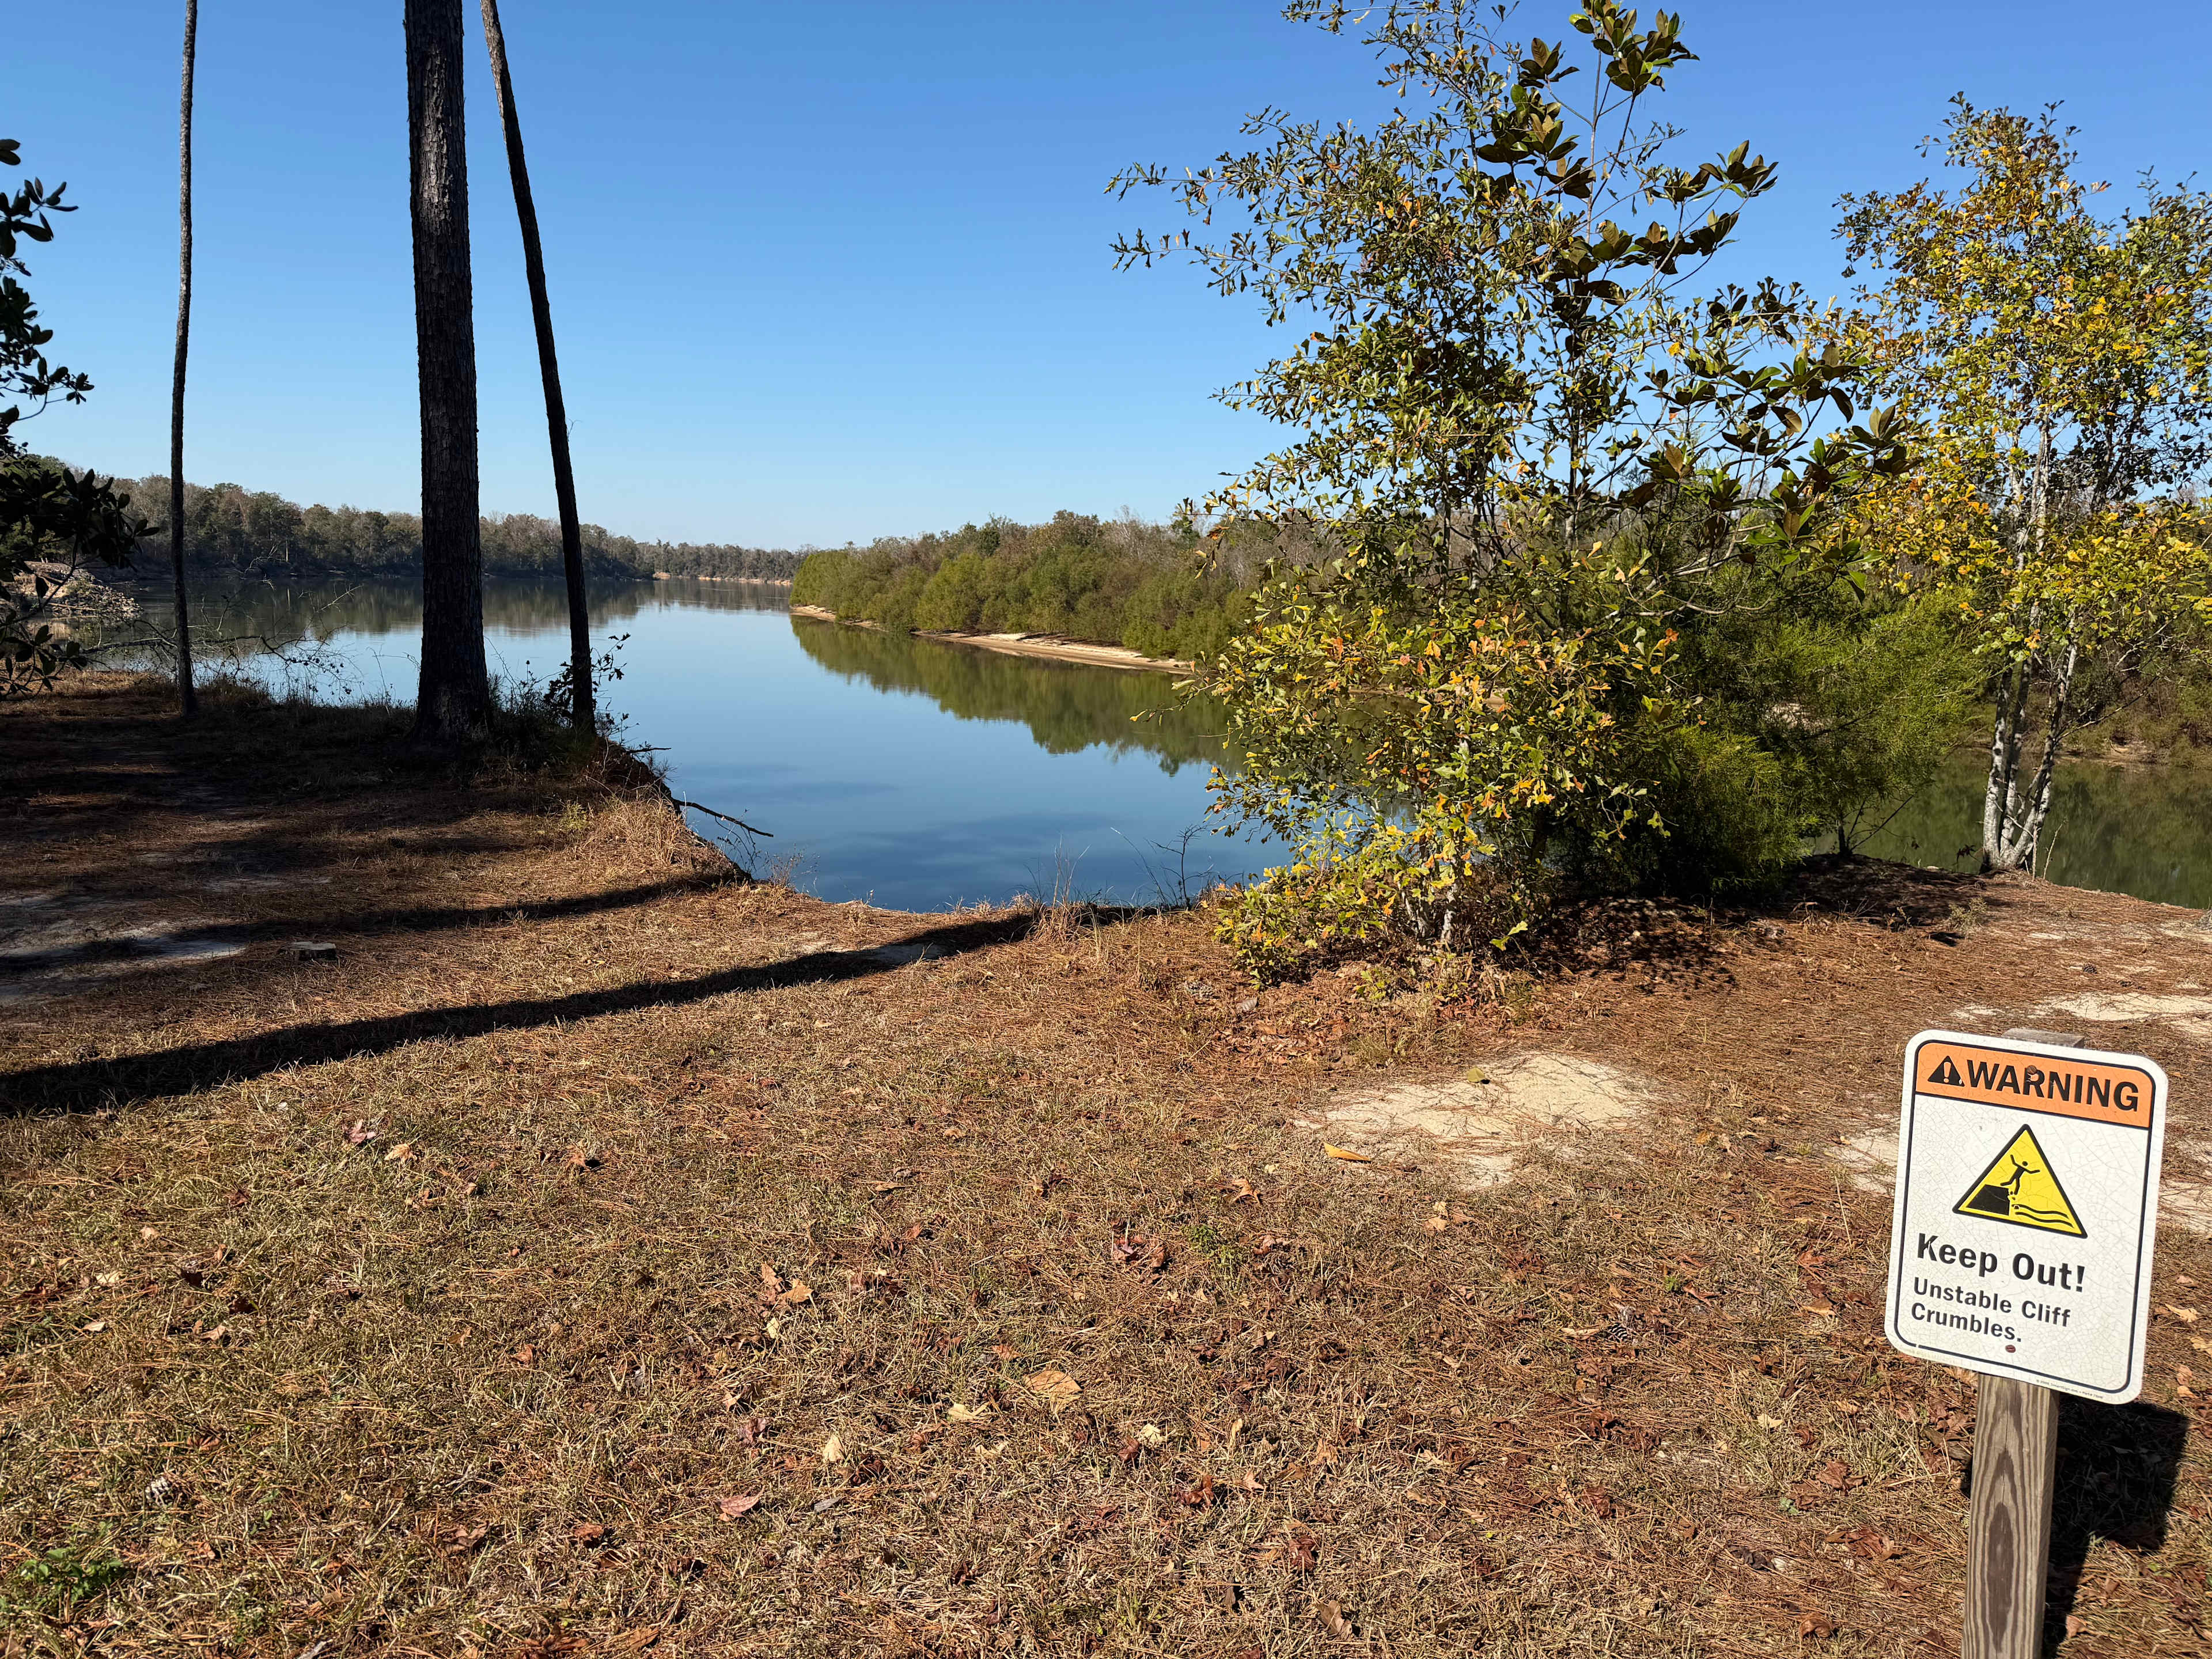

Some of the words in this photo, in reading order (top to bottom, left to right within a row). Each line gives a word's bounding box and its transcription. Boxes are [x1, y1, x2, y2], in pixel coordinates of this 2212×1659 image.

[1966, 1059, 2139, 1113] WARNING
[1917, 1232, 1998, 1278] Keep
[2013, 1252, 2085, 1293] Out!
[1911, 1302, 2022, 1343] Crumbles.
[1914, 1276, 2012, 1314] Unstable
[2022, 1300, 2071, 1327] Cliff
